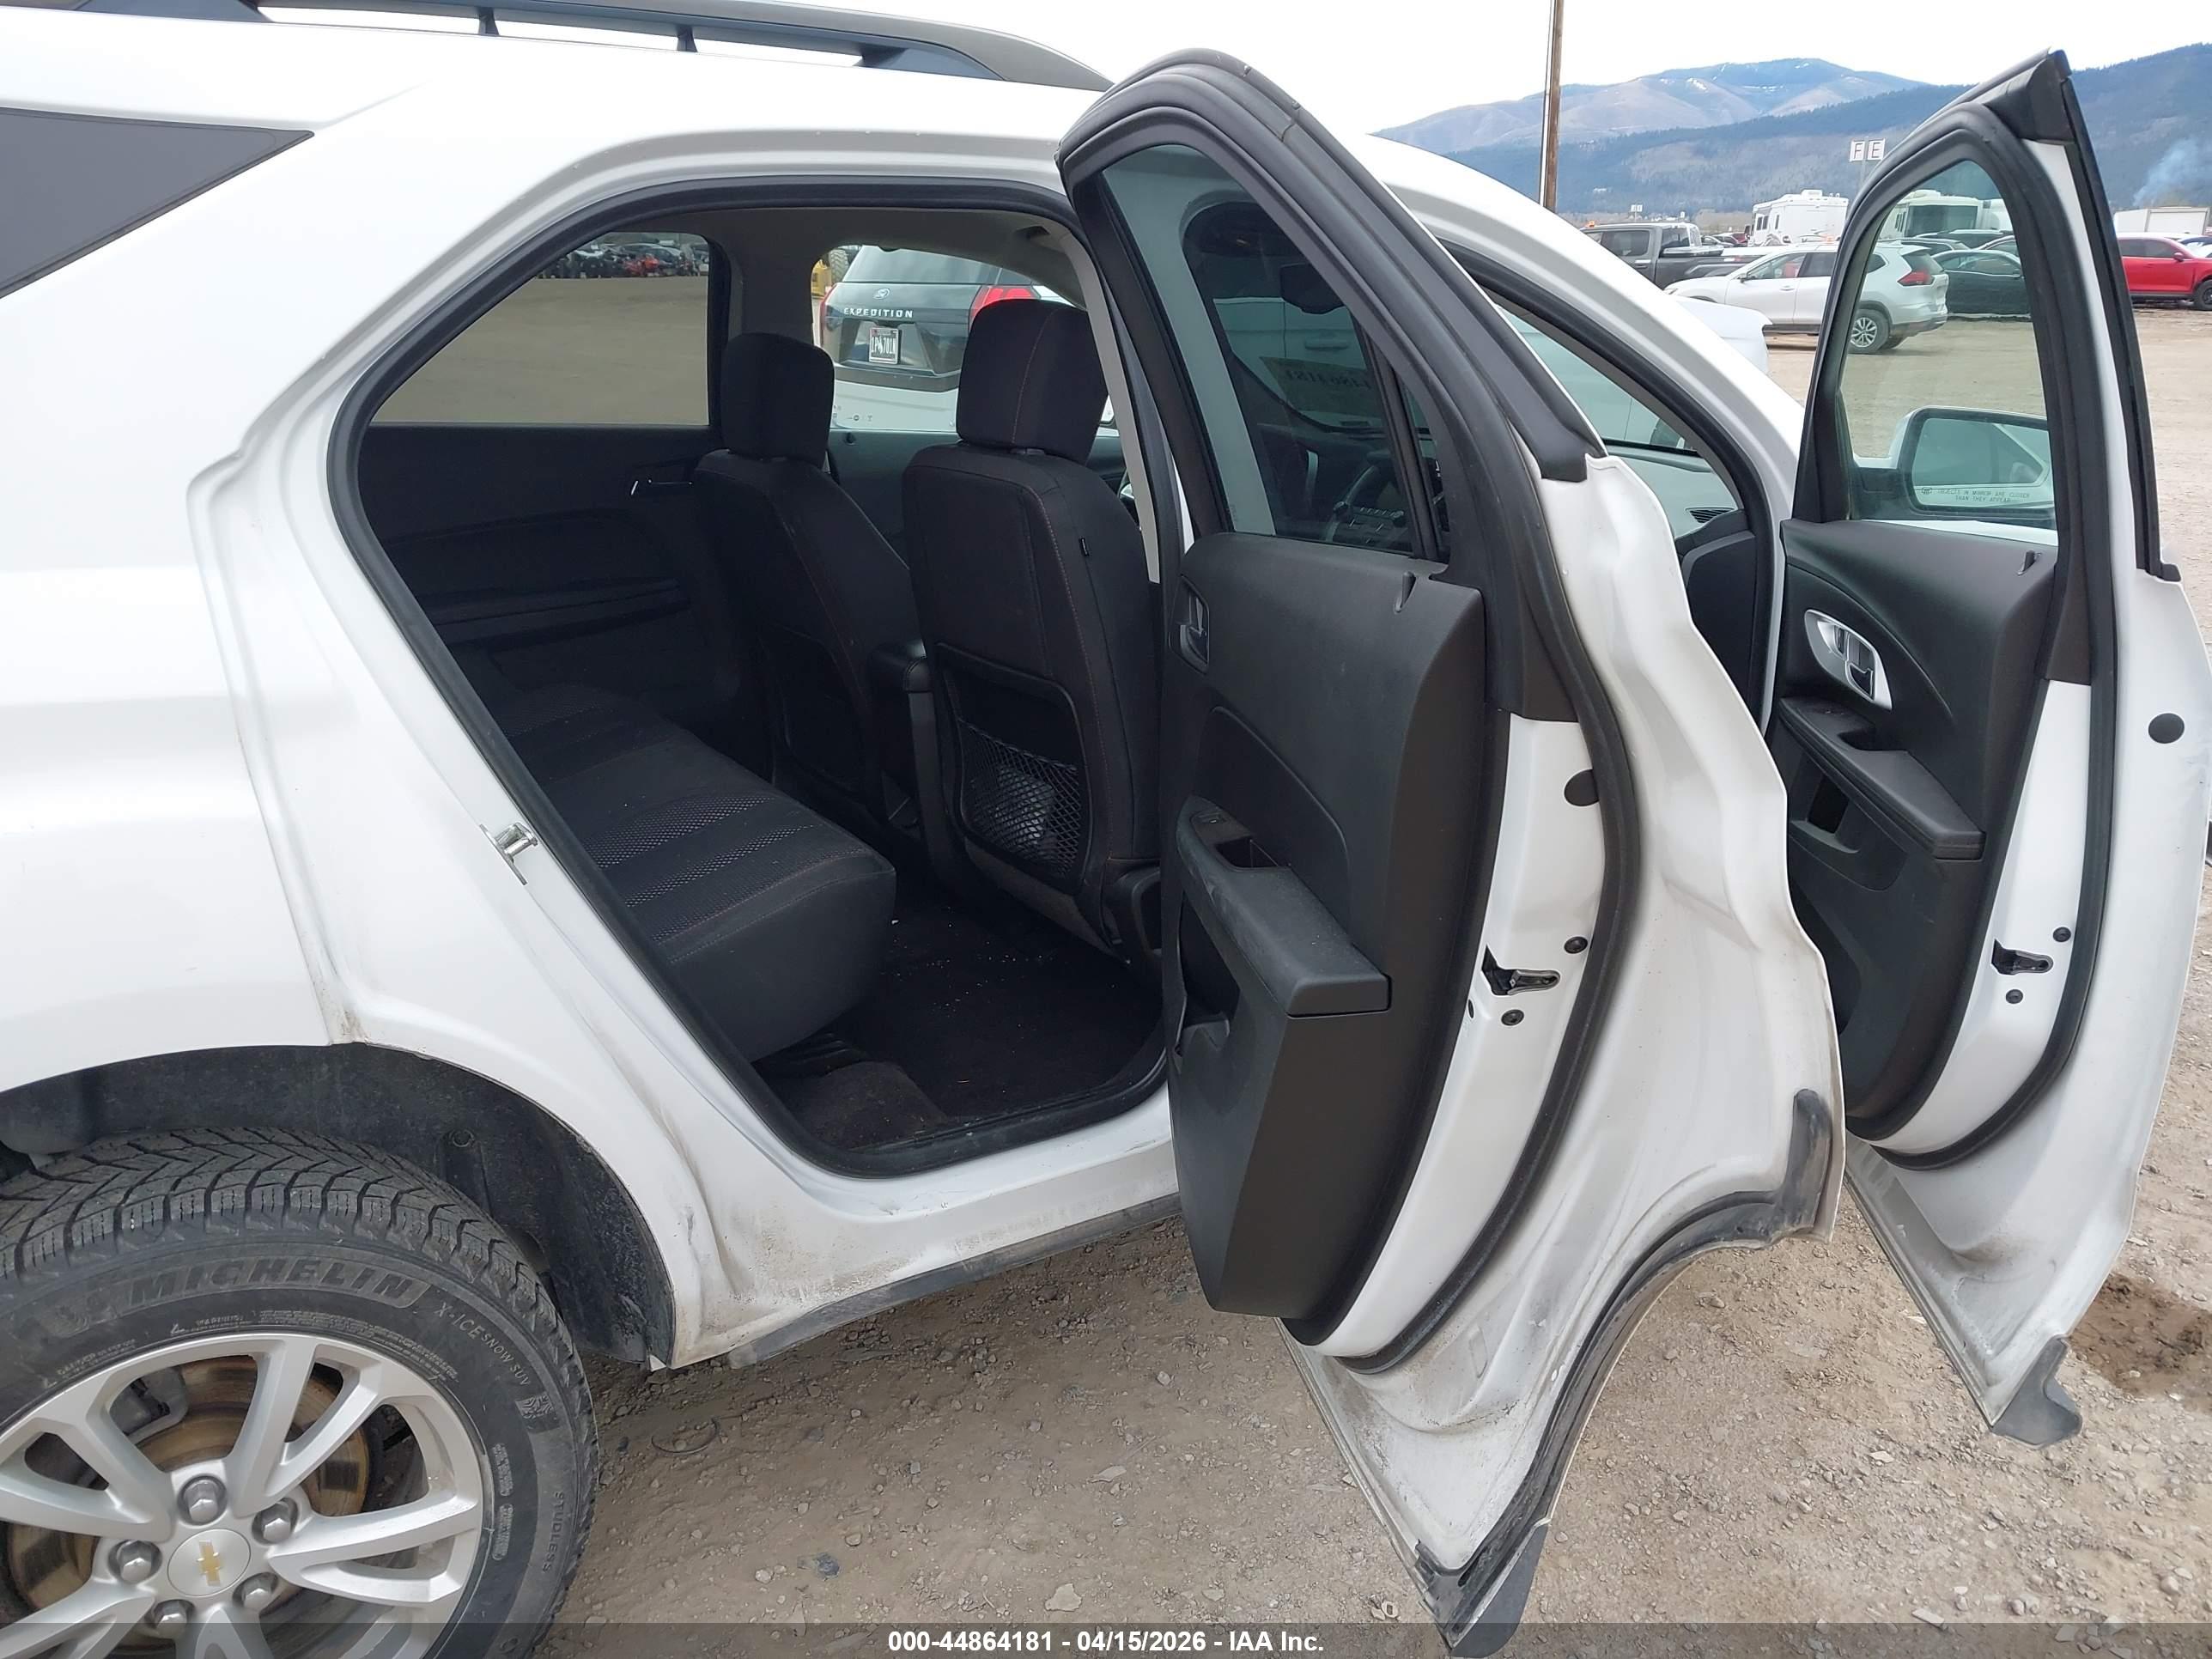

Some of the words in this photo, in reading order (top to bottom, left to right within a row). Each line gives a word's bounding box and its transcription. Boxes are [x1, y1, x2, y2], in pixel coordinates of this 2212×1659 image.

[1853, 143, 1863, 159] F
[1871, 142, 1881, 158] E
[843, 307, 914, 318] EXPEDITION
[131, 1258, 414, 1305] MICHELIN
[481, 1333, 514, 1363] SNOW
[509, 1364, 532, 1385] SUV
[542, 1490, 564, 1574] STUDLESS
